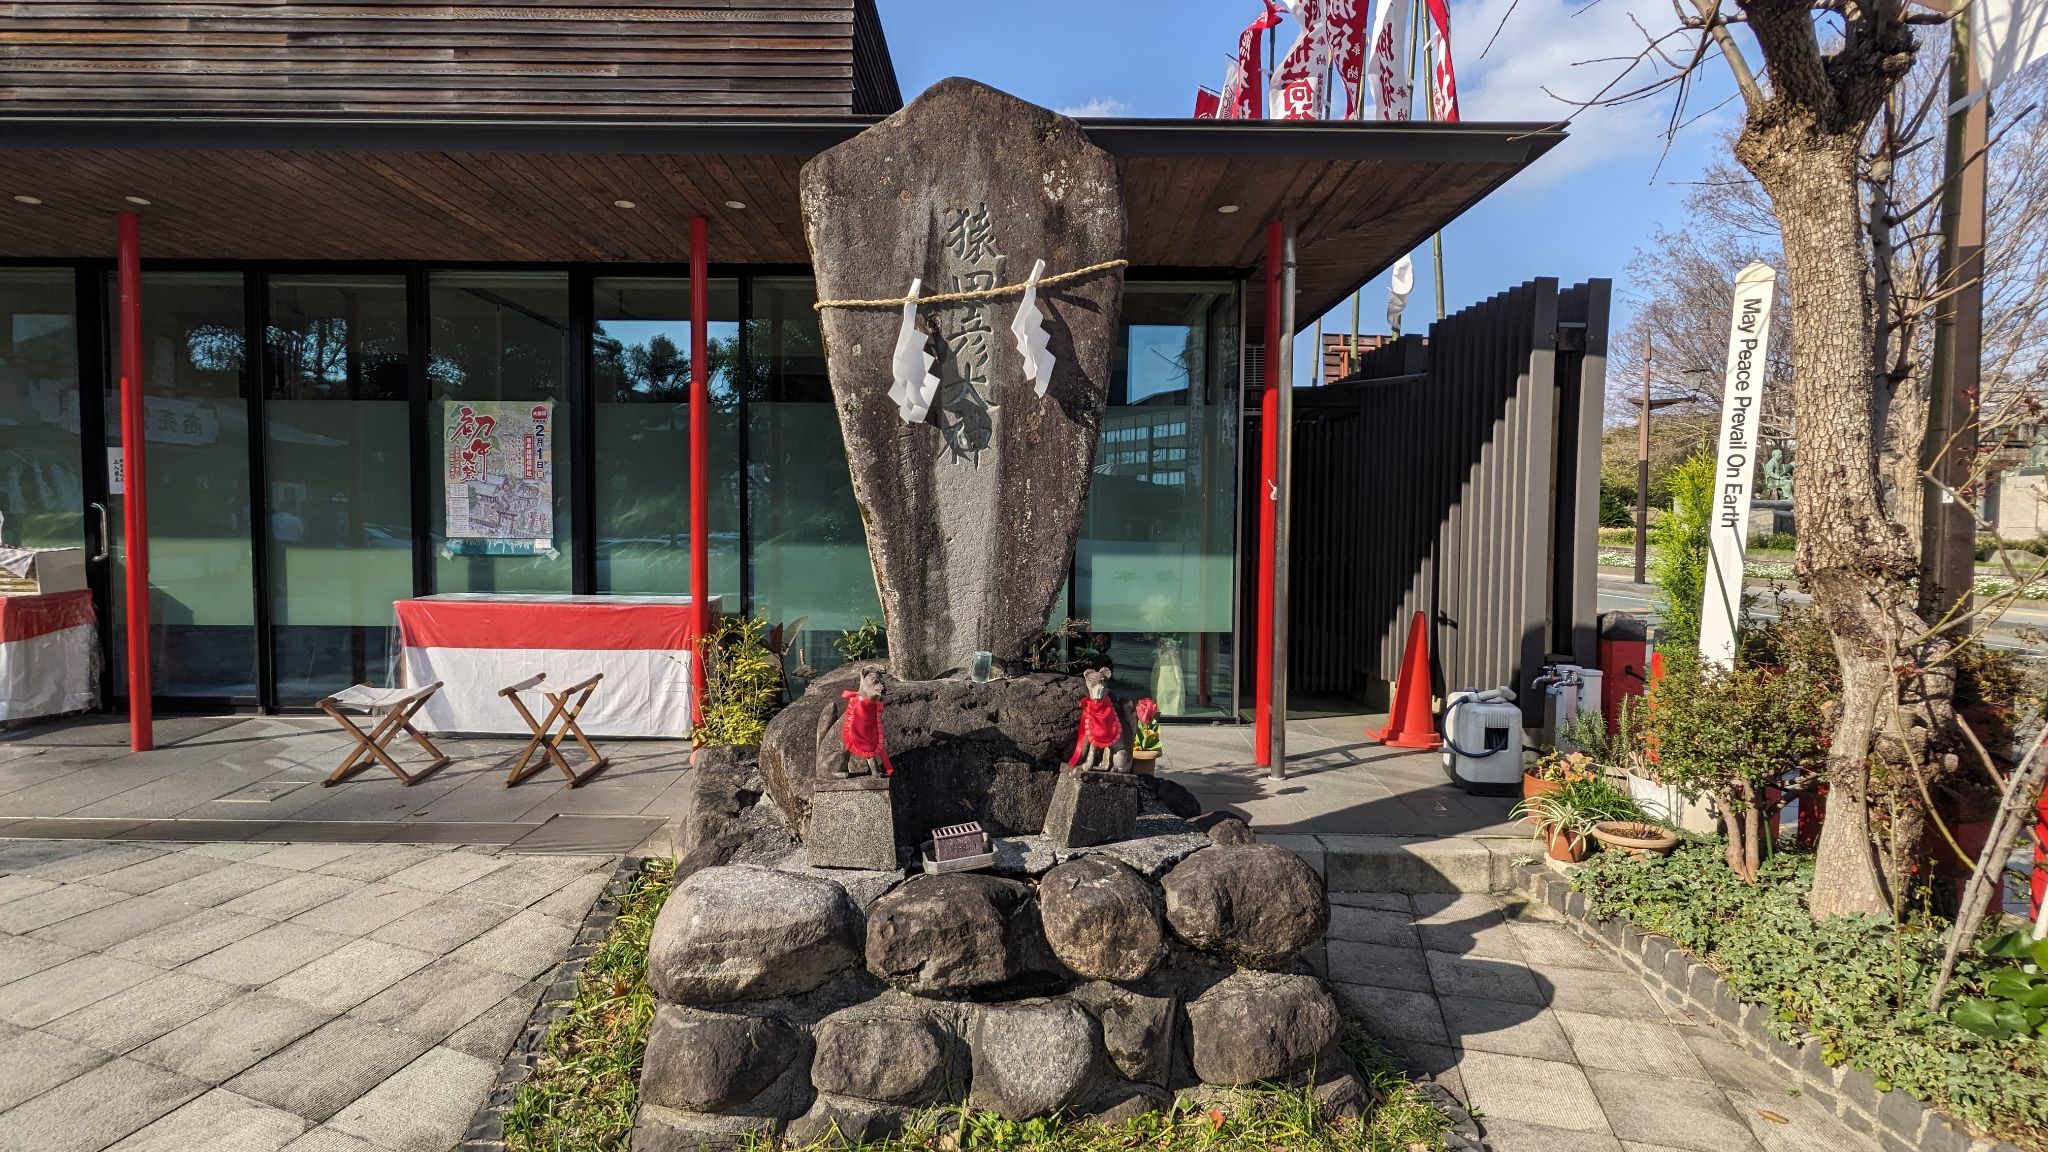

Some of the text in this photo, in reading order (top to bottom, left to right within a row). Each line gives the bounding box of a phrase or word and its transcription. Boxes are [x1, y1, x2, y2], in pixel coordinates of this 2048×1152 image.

[938, 201, 1006, 471] 猿田彦大神
[1721, 298, 1762, 530] May Peace Prevail On Earth
